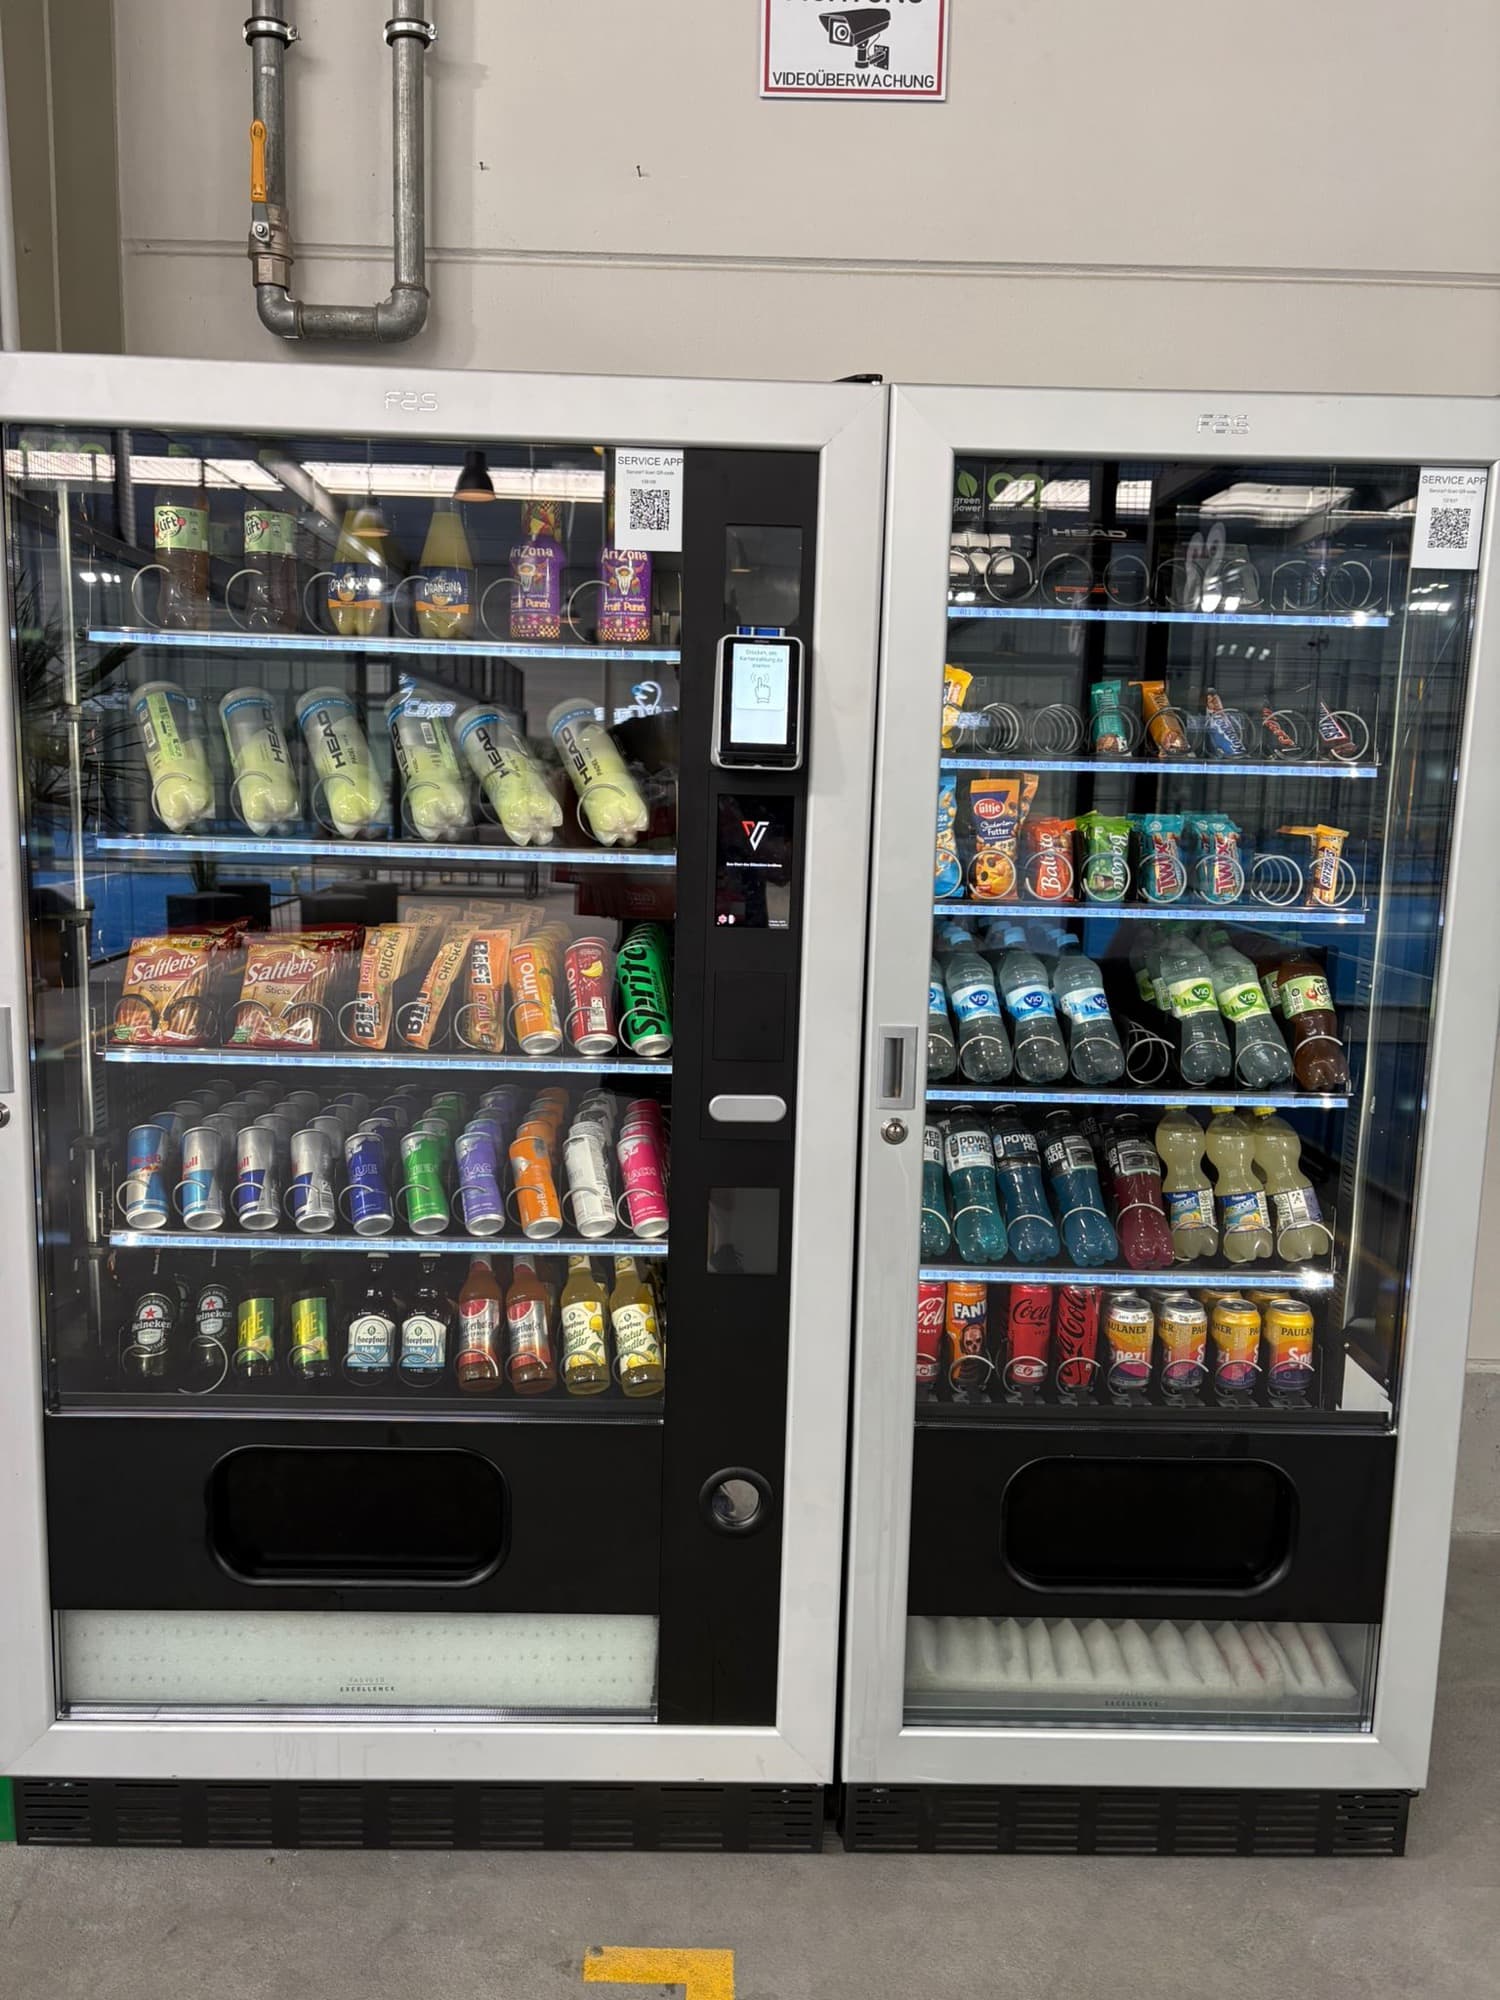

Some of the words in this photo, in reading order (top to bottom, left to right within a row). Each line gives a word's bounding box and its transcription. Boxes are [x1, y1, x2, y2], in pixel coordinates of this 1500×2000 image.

[773, 69, 934, 88] VIDEOÜBERWACHUNG
[617, 456, 661, 466] SERVICE
[663, 457, 684, 466] APP
[1421, 475, 1465, 485] SERVICE
[1466, 477, 1488, 485] APP
[953, 497, 981, 505] green
[1052, 528, 1127, 538] HEAD
[509, 545, 554, 560] AriZona
[600, 549, 648, 563] AriZona
[525, 598, 551, 609] Punch
[623, 601, 647, 612] Punch
[261, 702, 286, 764] HEAD
[316, 709, 346, 769] HEAD
[391, 722, 413, 784] HEAD
[475, 726, 511, 779] HEAD
[560, 726, 593, 786] HEAD
[978, 802, 1002, 815] ültje
[1040, 832, 1062, 892] Balisto
[378, 931, 401, 980] CHICKEN
[127, 953, 200, 985] Saltletts
[243, 957, 318, 987] Saltletts
[148, 983, 172, 994] Sticks
[264, 984, 291, 996] Sticks
[620, 947, 667, 1036] Sprite
[960, 1134, 989, 1146] POWE
[1003, 1133, 1035, 1145] POWE
[953, 1299, 987, 1319] FANT
[1107, 1320, 1147, 1335] AULANER
[1281, 1326, 1313, 1337] PAULA
